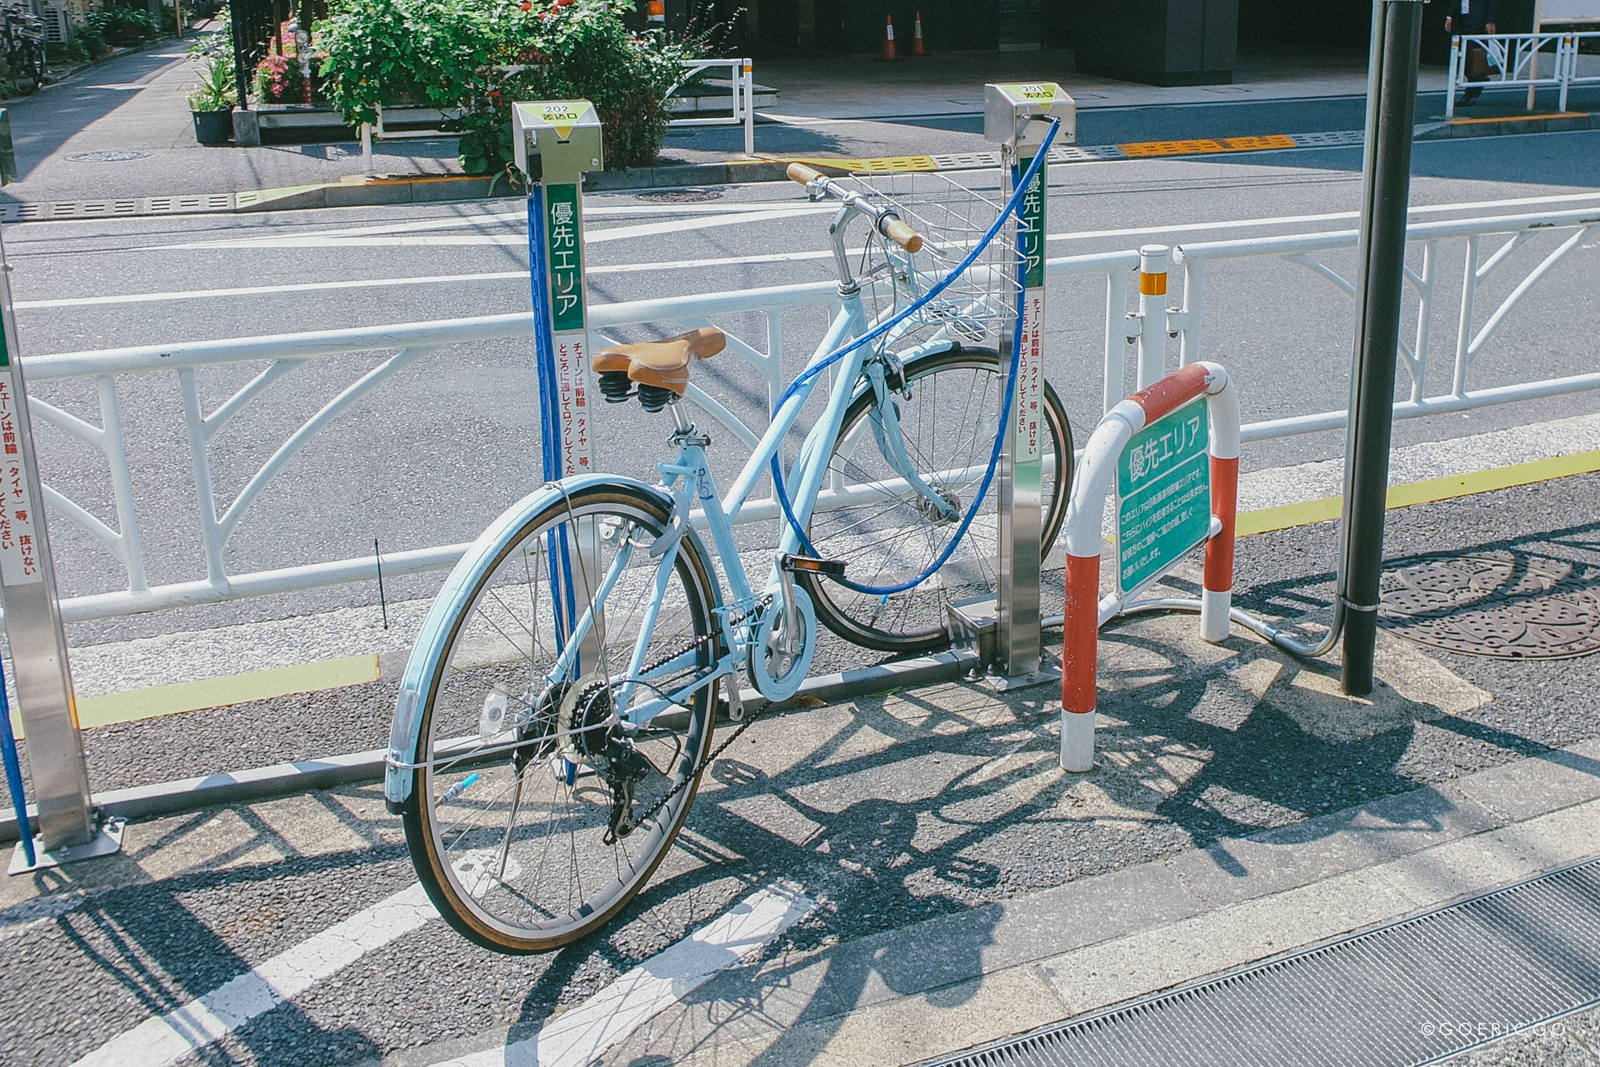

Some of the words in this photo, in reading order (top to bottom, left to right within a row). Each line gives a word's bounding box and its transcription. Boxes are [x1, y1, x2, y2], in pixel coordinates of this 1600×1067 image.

[551, 202, 578, 316] 優先エリア
[559, 344, 575, 477] ところに通してロックしてくだ
[1128, 415, 1199, 484] 優先エリア
